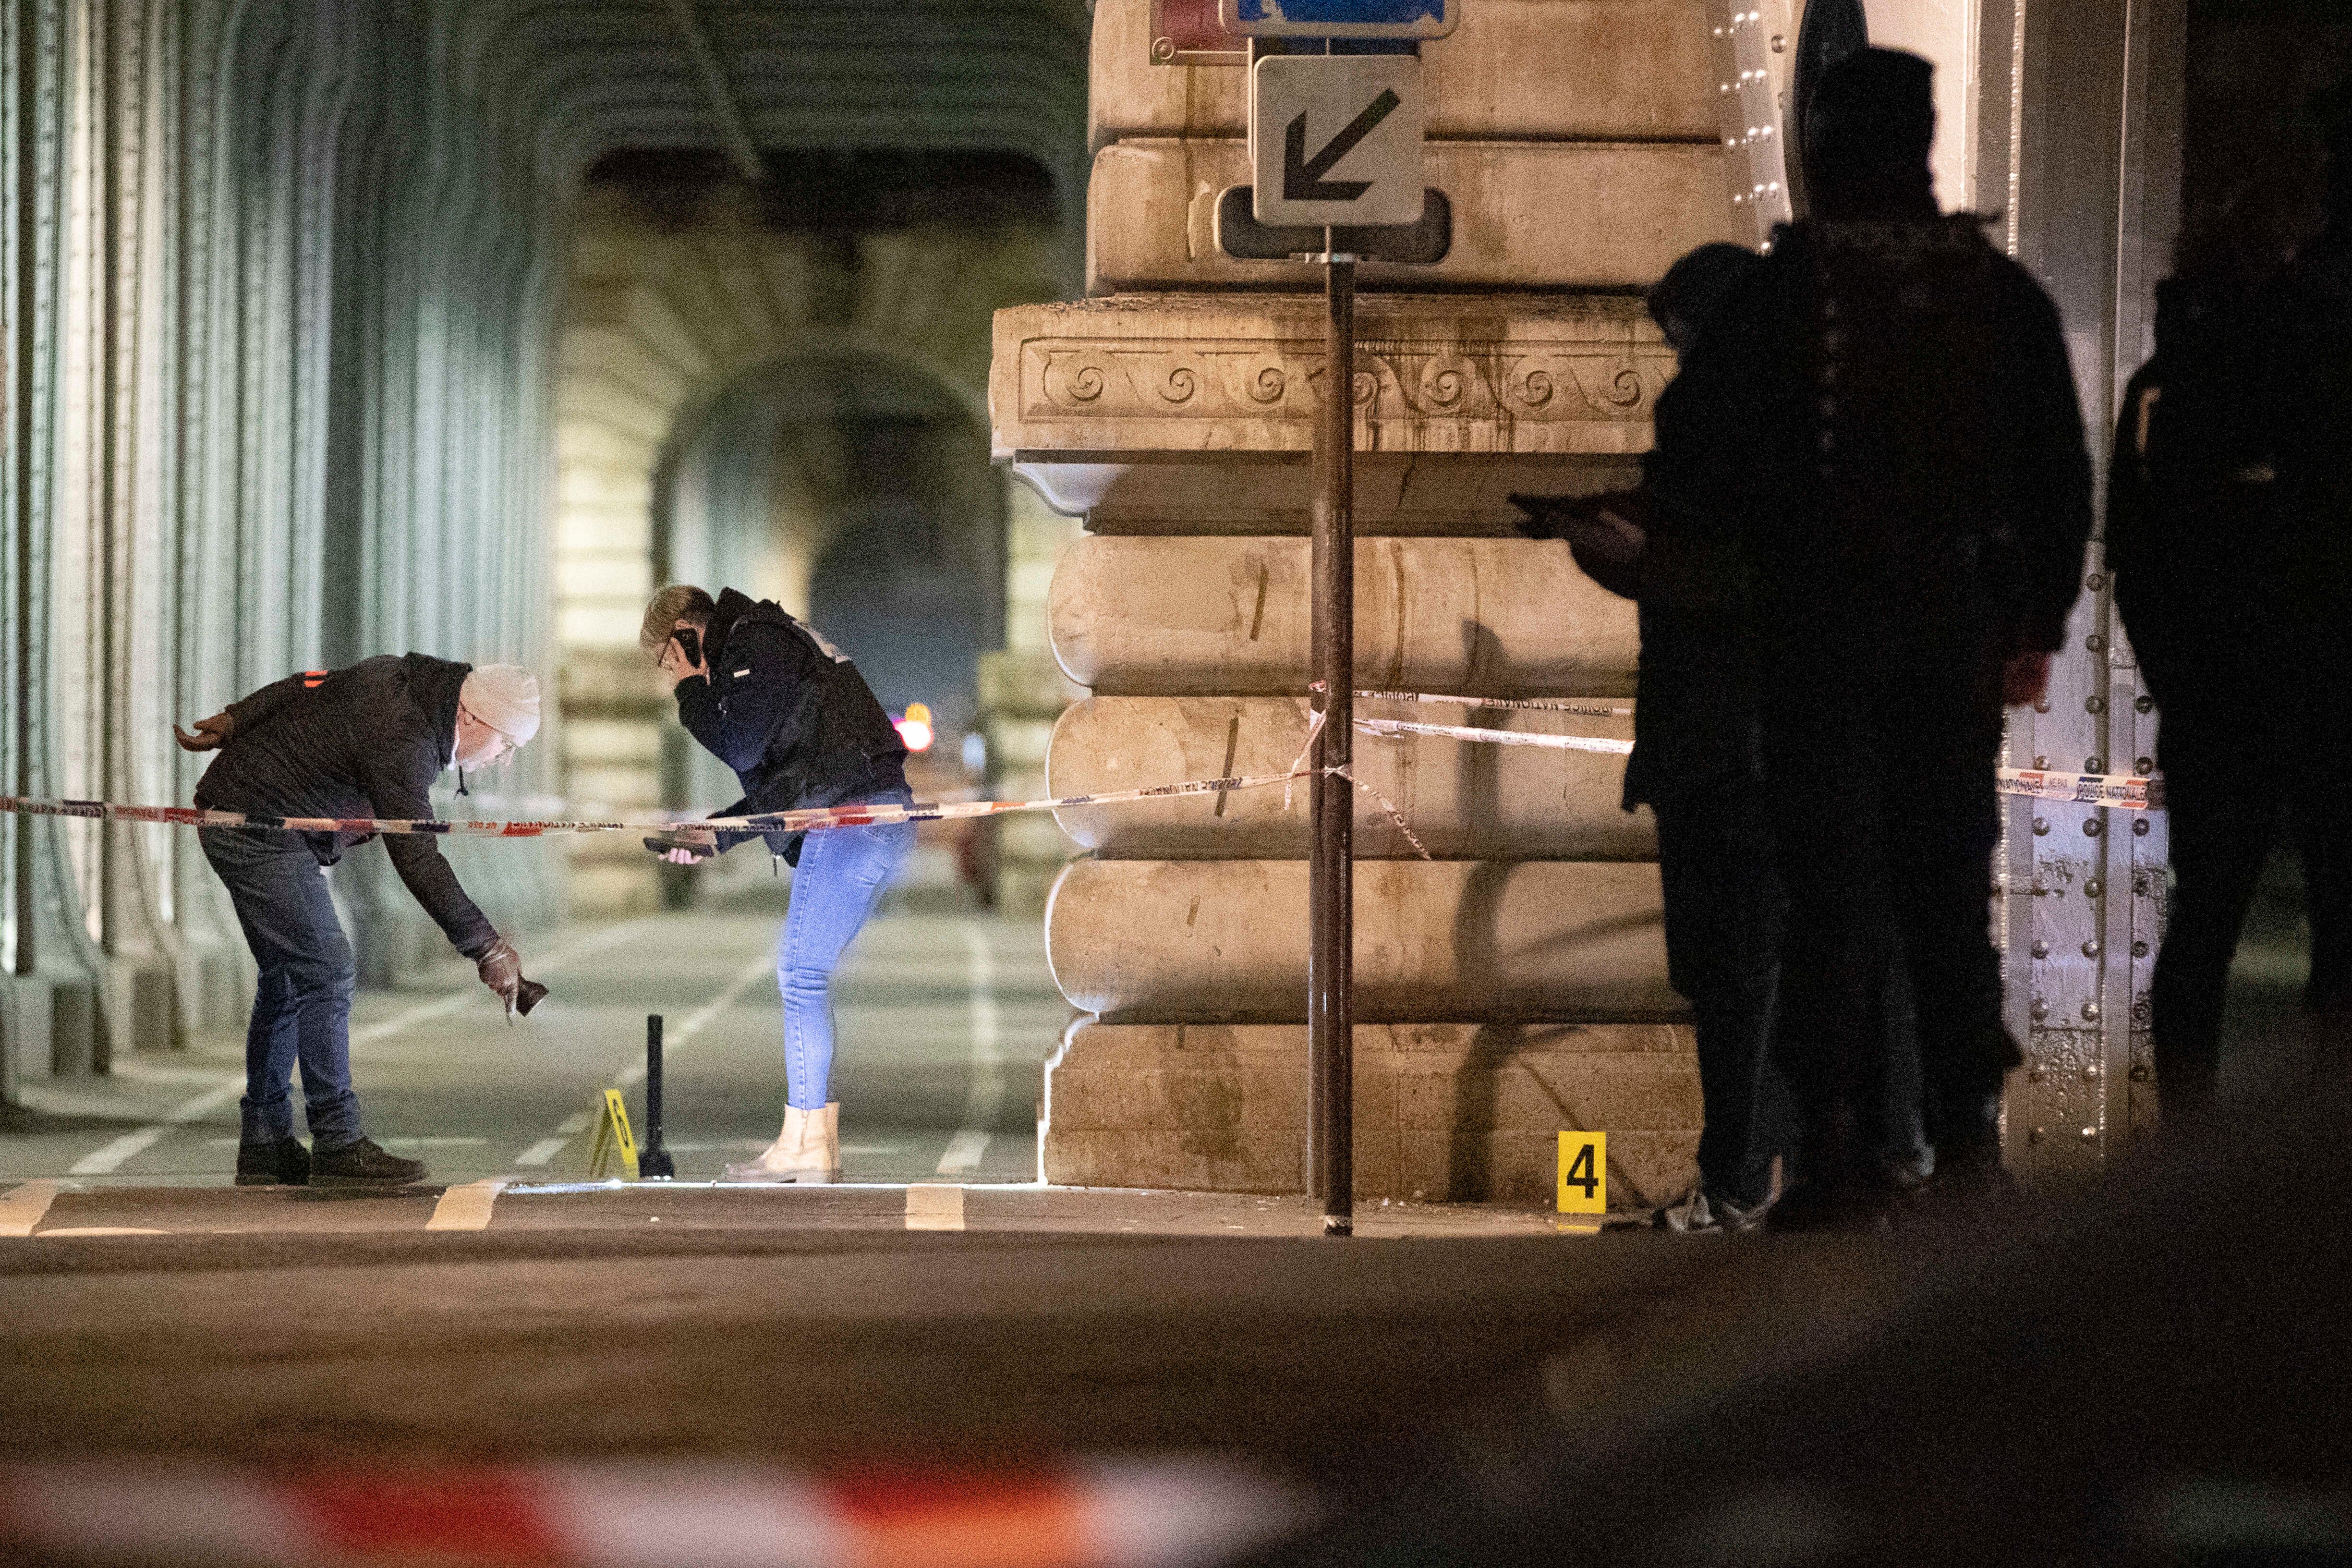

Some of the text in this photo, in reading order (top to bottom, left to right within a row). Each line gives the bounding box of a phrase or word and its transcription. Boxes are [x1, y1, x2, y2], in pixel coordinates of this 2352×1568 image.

[2076, 783, 2104, 799] POLICE
[2106, 786, 2146, 800] NATIONALE
[1566, 1144, 1599, 1199] 4
